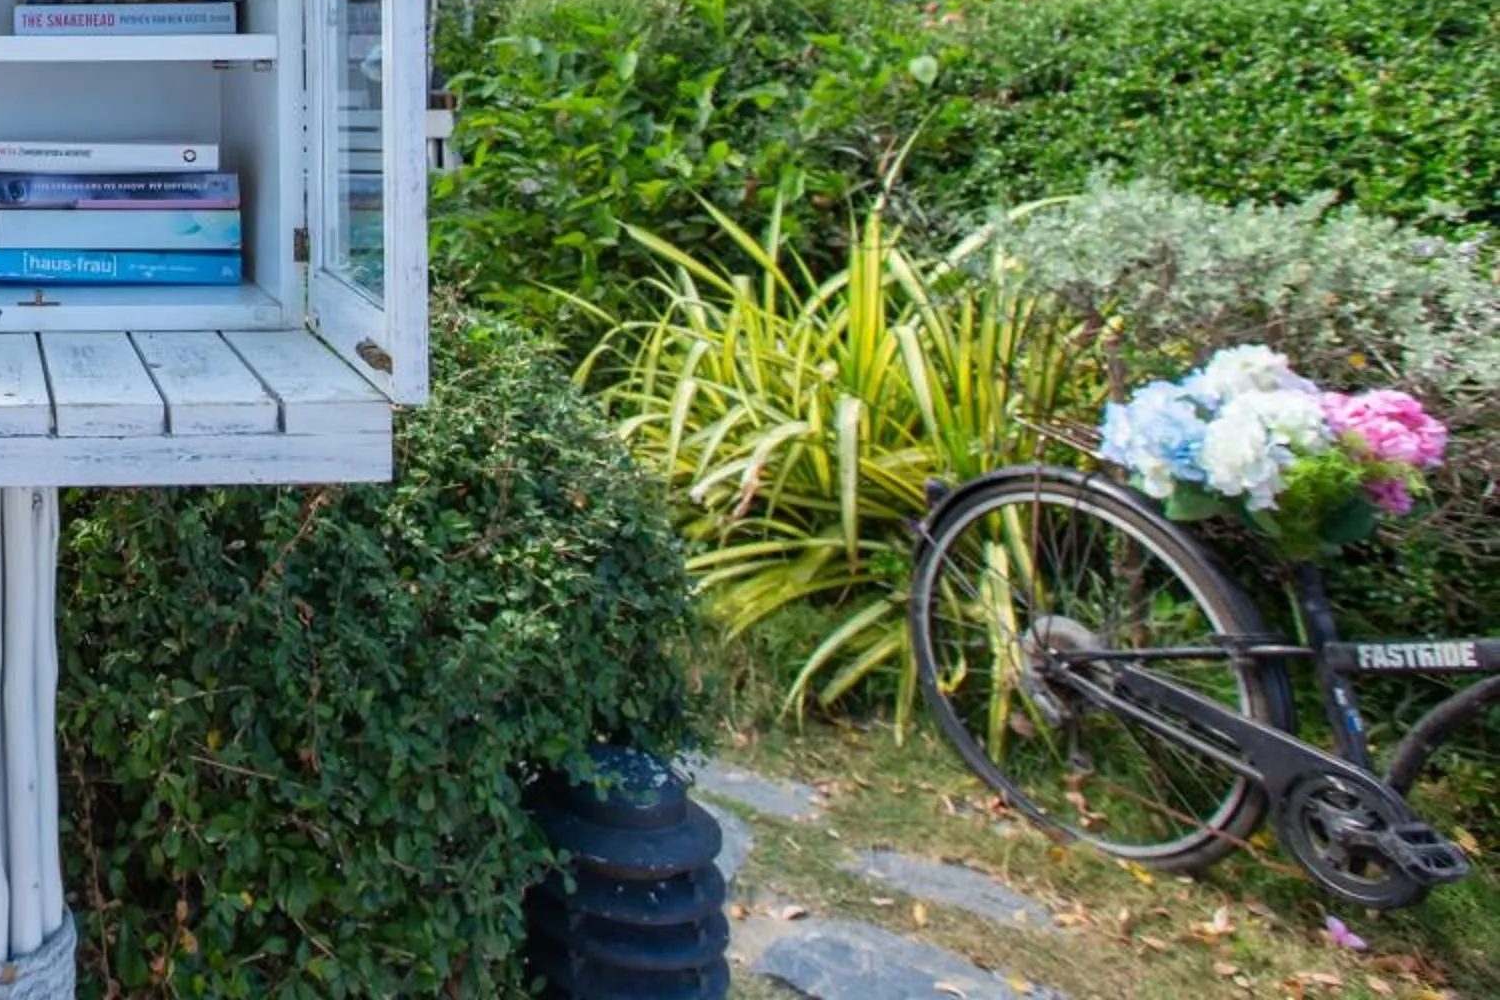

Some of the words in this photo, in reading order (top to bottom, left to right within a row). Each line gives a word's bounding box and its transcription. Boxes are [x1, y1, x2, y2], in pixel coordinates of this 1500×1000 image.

[22, 13, 43, 28] THE
[46, 13, 115, 28] SNAKEHEAD
[1357, 641, 1479, 669] FASTRIDE
